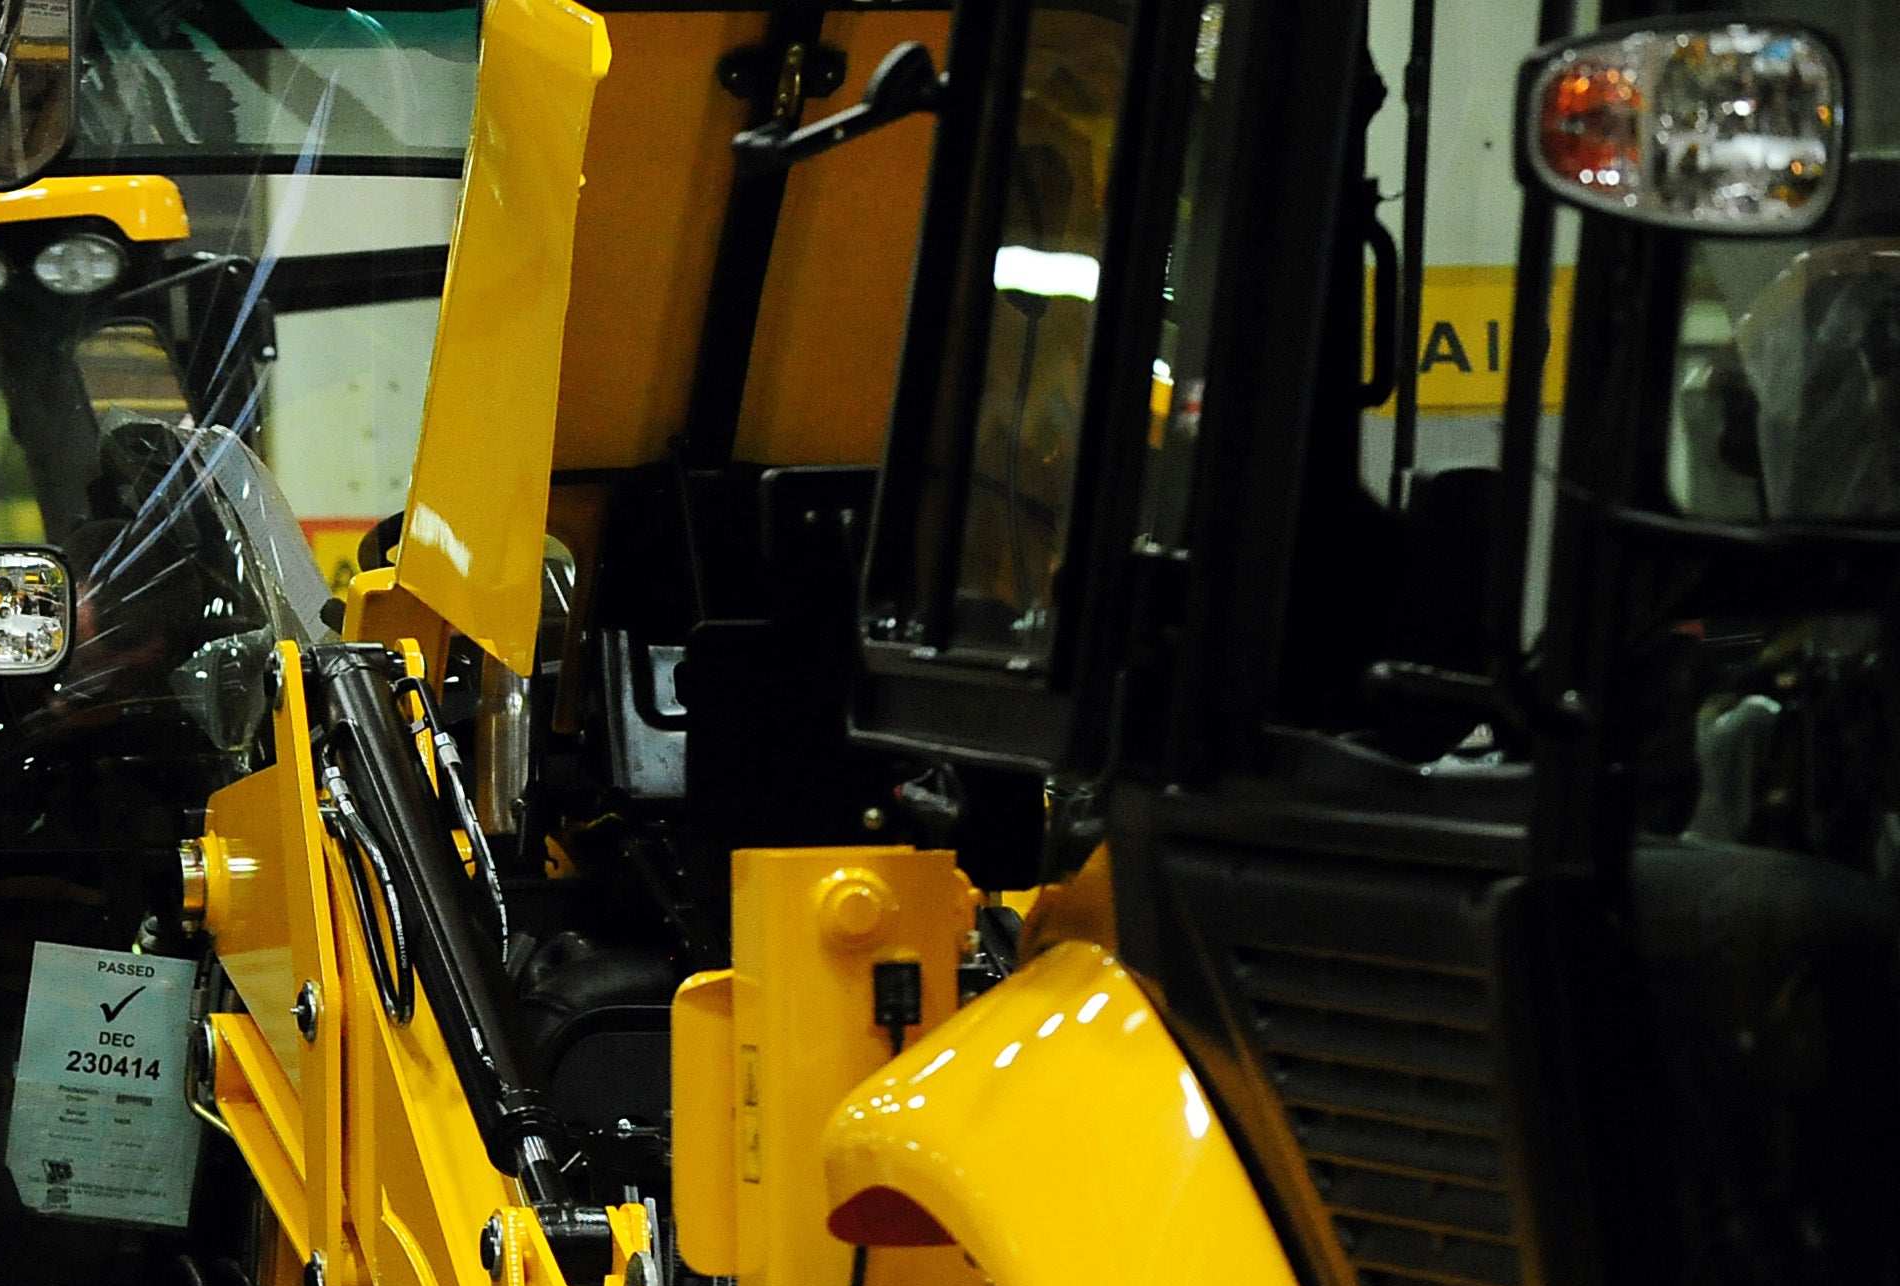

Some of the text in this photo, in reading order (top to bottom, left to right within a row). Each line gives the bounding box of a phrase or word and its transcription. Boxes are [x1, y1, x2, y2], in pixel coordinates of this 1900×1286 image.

[97, 960, 155, 978] PASSED
[98, 1031, 136, 1048] DEC
[65, 1050, 160, 1081] 230414
